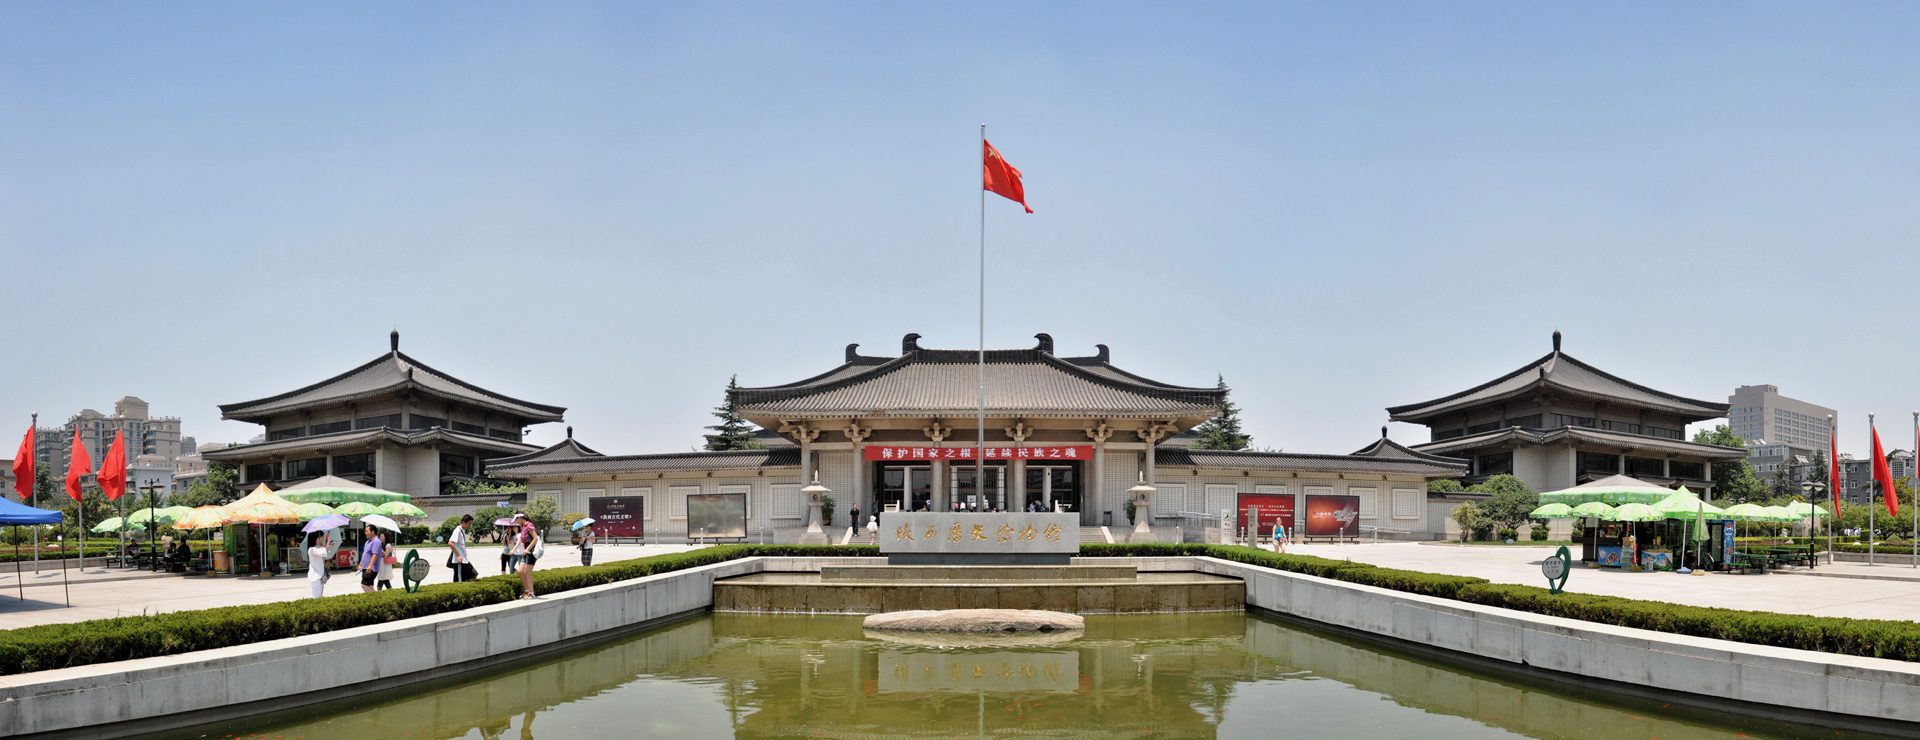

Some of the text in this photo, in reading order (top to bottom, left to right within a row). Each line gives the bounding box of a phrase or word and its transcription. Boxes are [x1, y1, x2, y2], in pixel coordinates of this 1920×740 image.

[882, 447, 1077, 459] 保护国家之根 延续民族之魂
